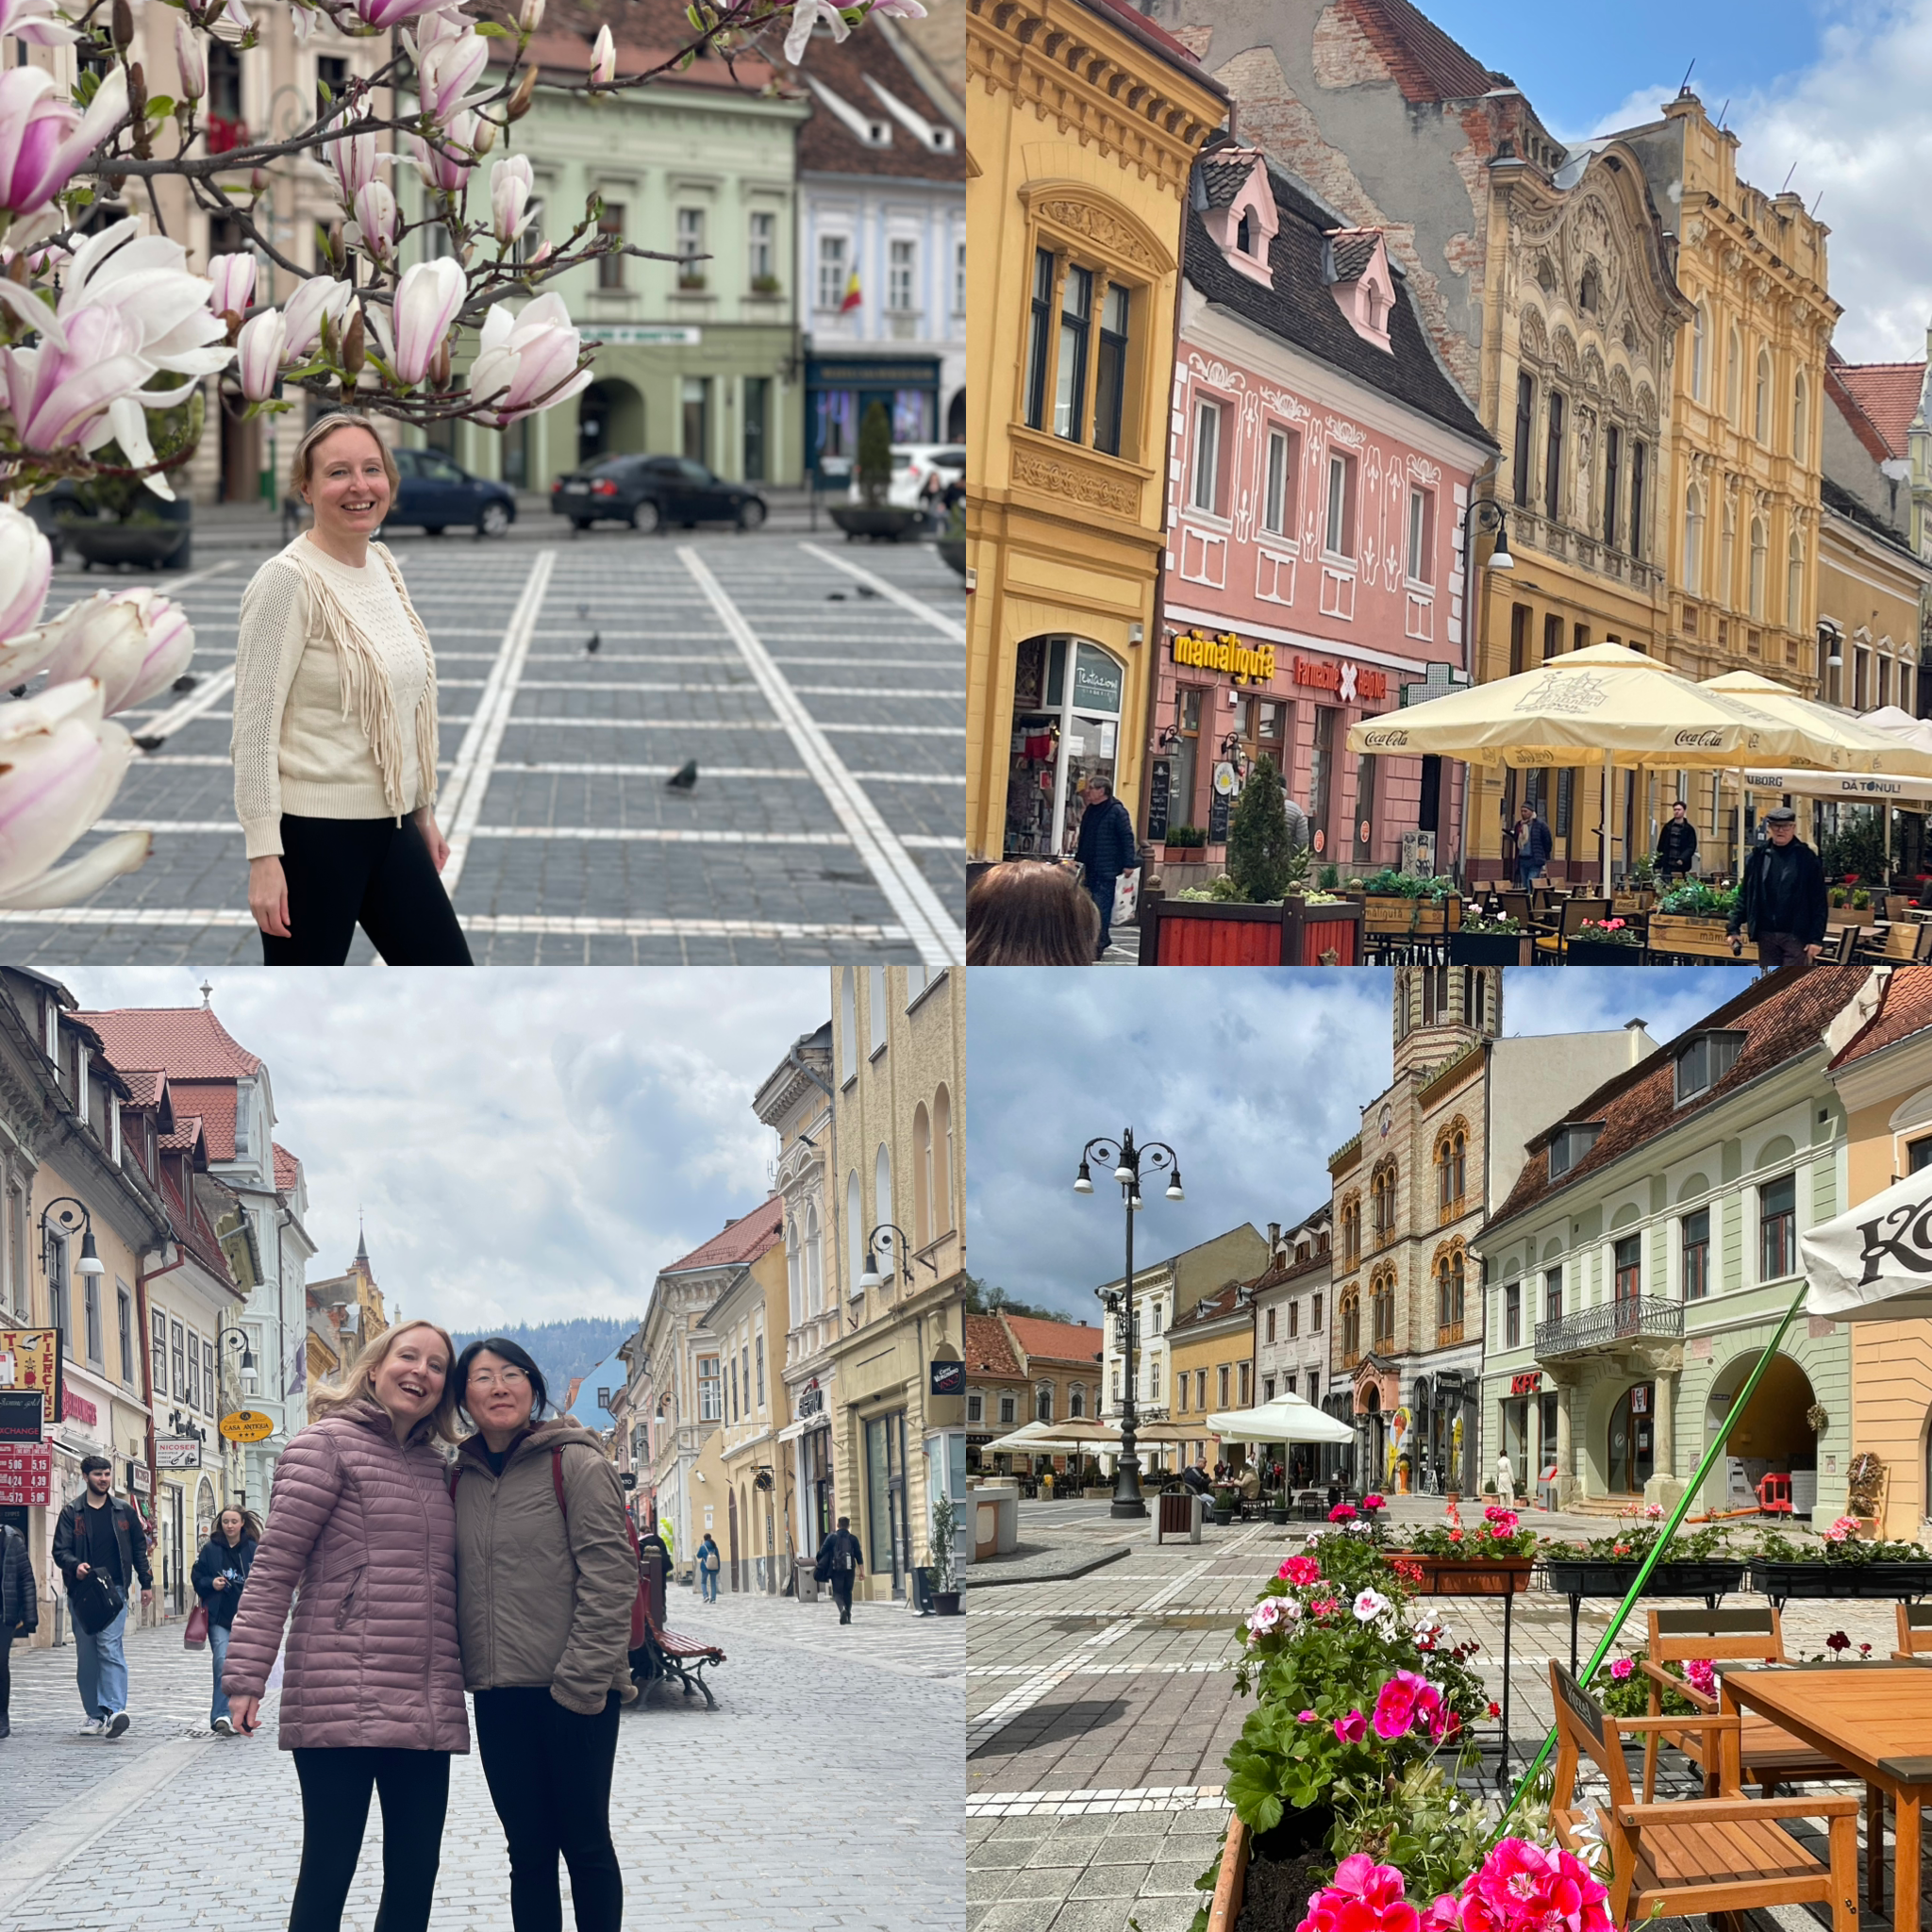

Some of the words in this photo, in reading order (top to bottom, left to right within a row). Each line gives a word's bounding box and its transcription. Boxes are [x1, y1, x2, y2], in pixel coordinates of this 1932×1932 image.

[1174, 629, 1275, 685] mămăliguță
[1358, 668, 1374, 700] Help
[1747, 775, 1783, 787] UBORG
[1511, 1372, 1541, 1393] KFC
